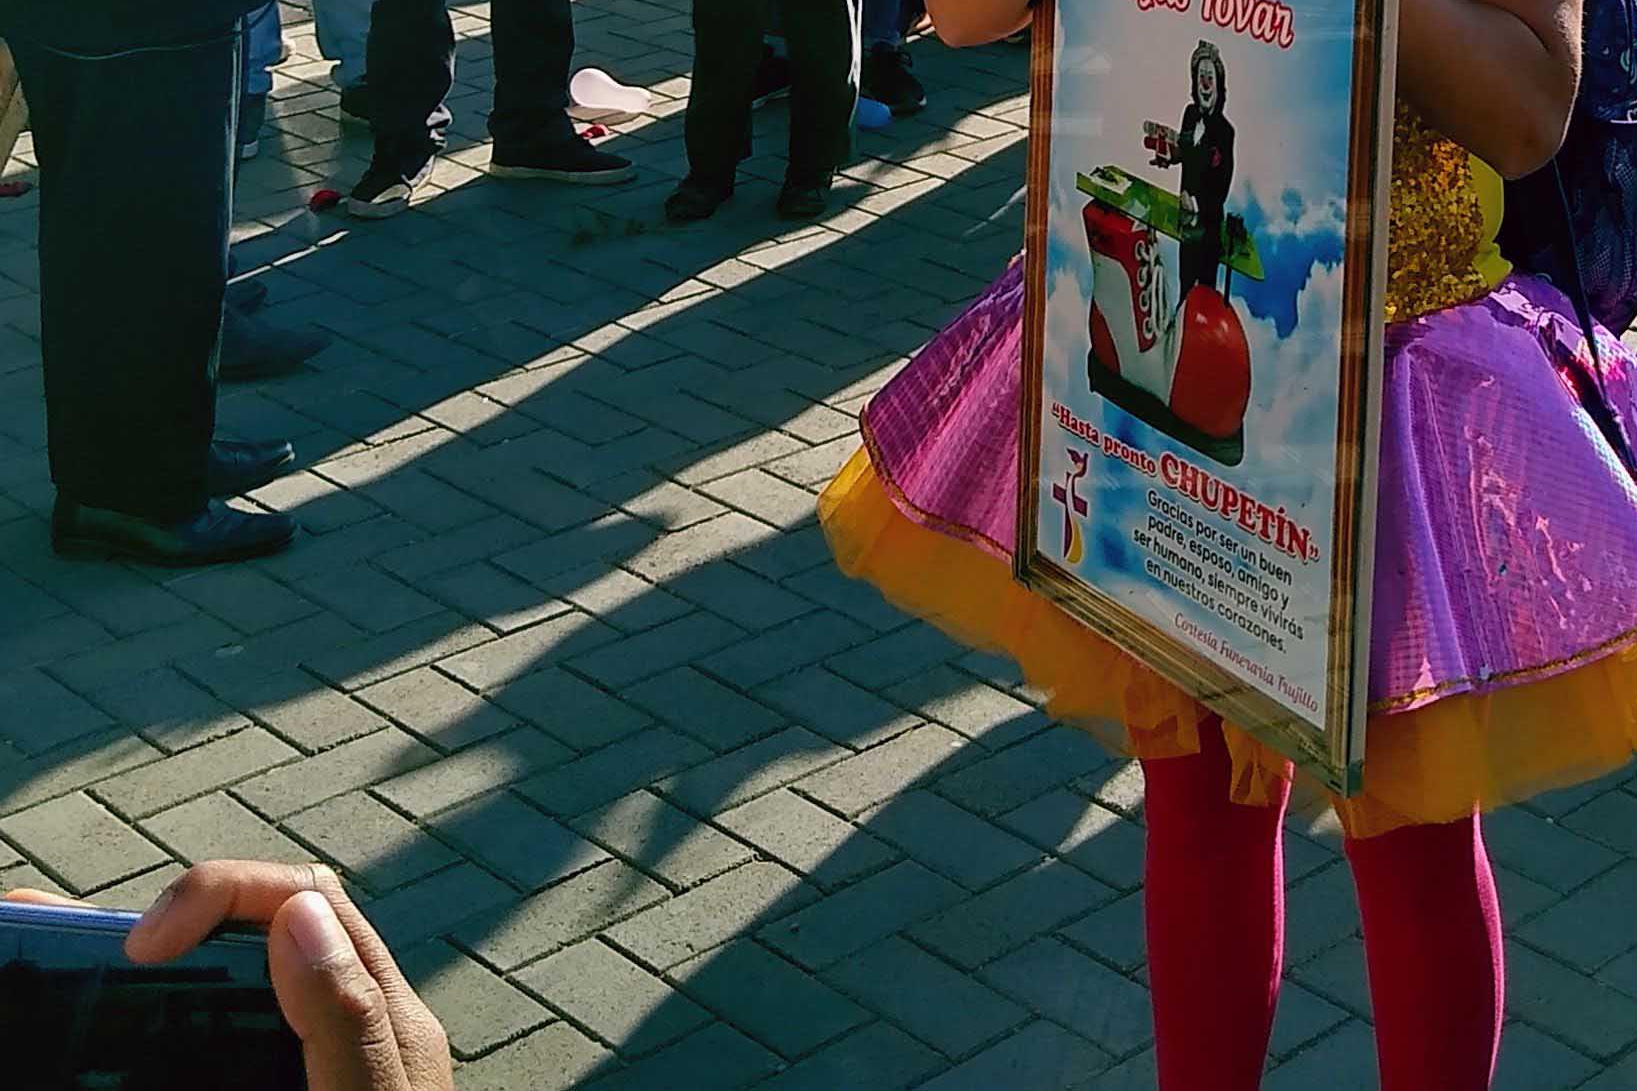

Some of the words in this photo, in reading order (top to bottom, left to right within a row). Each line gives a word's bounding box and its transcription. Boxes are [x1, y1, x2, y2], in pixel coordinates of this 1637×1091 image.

[1103, 435, 1156, 476] pronto
[1134, 529, 1152, 548] ser
[1153, 537, 1206, 585] humano,
[1208, 572, 1258, 613] siempre
[1261, 605, 1304, 640] vivirás
[1148, 490, 1193, 528] Gracias
[1196, 520, 1217, 541] por
[1220, 533, 1238, 554] ser
[1241, 547, 1256, 565] un
[1259, 552, 1292, 586] buen
[1148, 515, 1186, 550] padre,
[1189, 540, 1235, 578] esposo,
[1238, 568, 1278, 601] amigo
[1281, 593, 1289, 610] y
[1146, 559, 1160, 577] en
[1163, 569, 1214, 610] nuestros
[1217, 603, 1287, 654] corazones.
[1220, 639, 1275, 687] Funeraria
[1277, 673, 1318, 713] Trujillo
